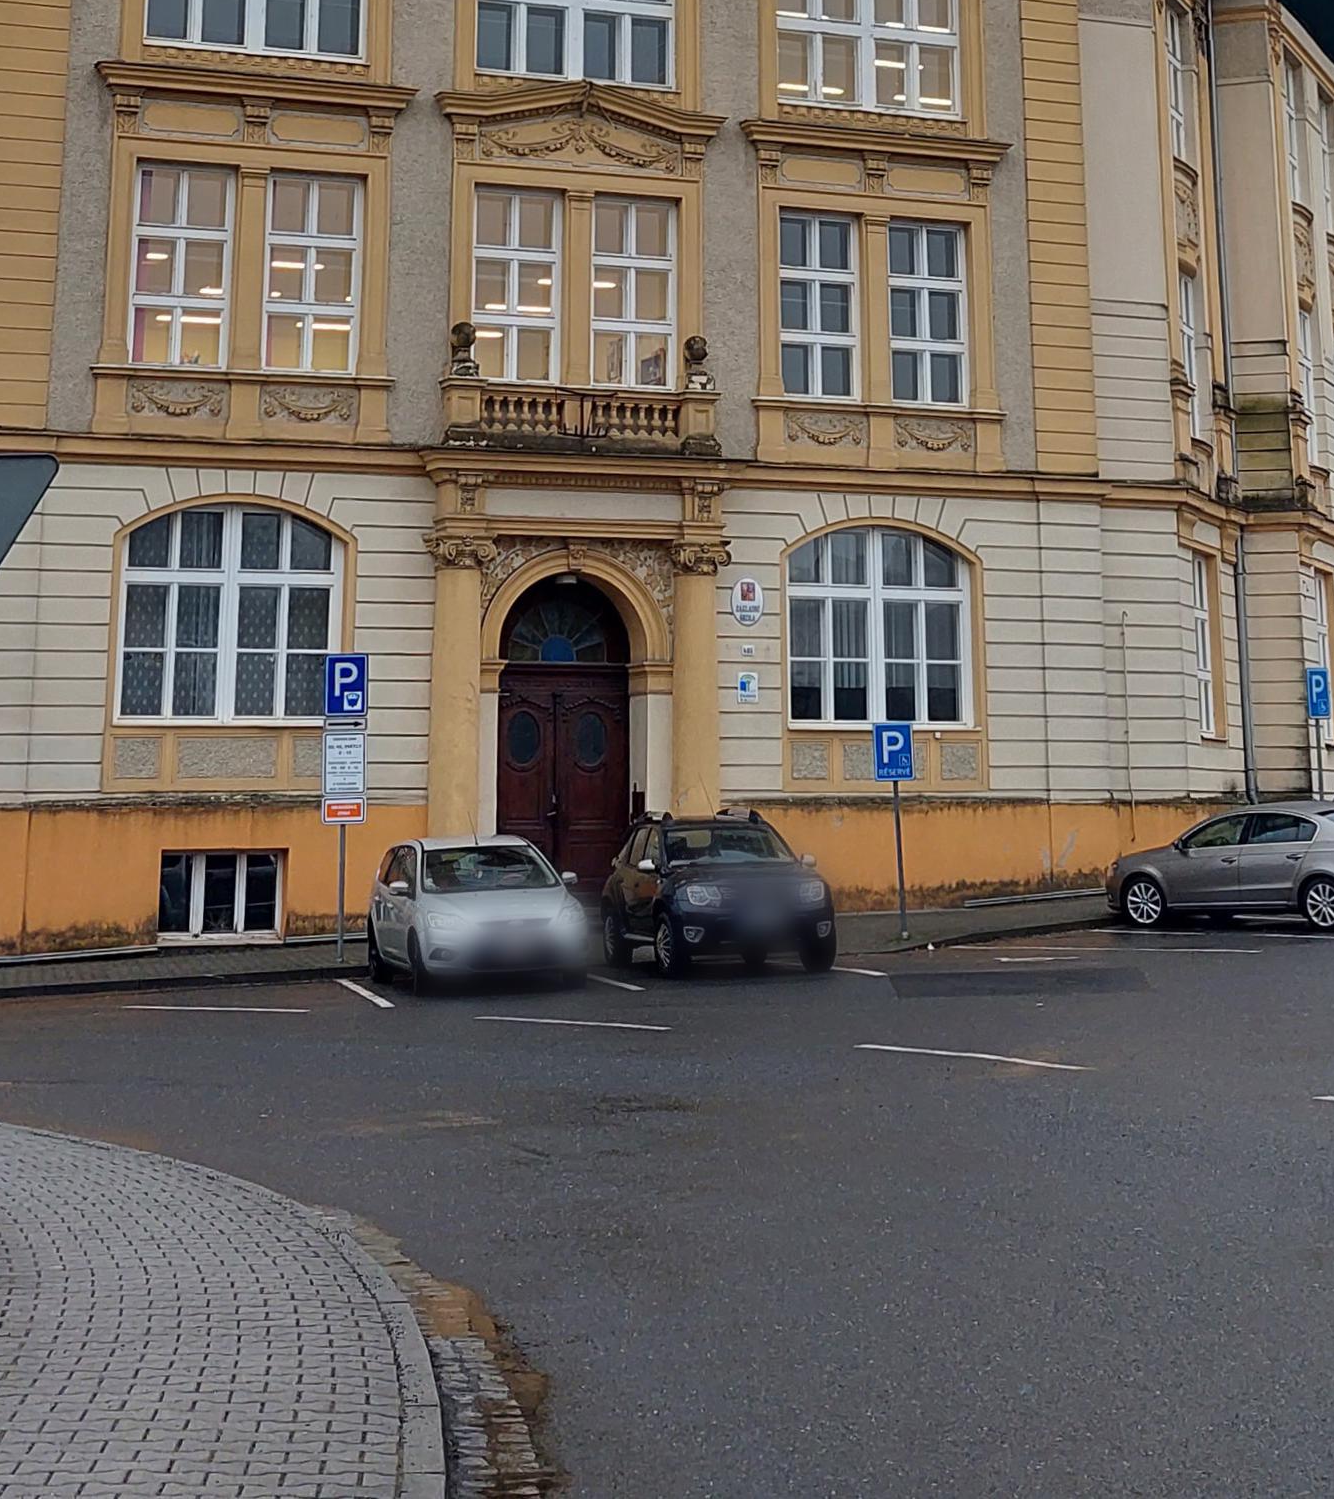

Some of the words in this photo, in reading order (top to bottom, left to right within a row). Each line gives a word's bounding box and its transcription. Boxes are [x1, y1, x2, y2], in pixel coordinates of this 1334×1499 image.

[334, 662, 359, 697] P
[1312, 675, 1324, 703] P
[882, 731, 904, 764] P
